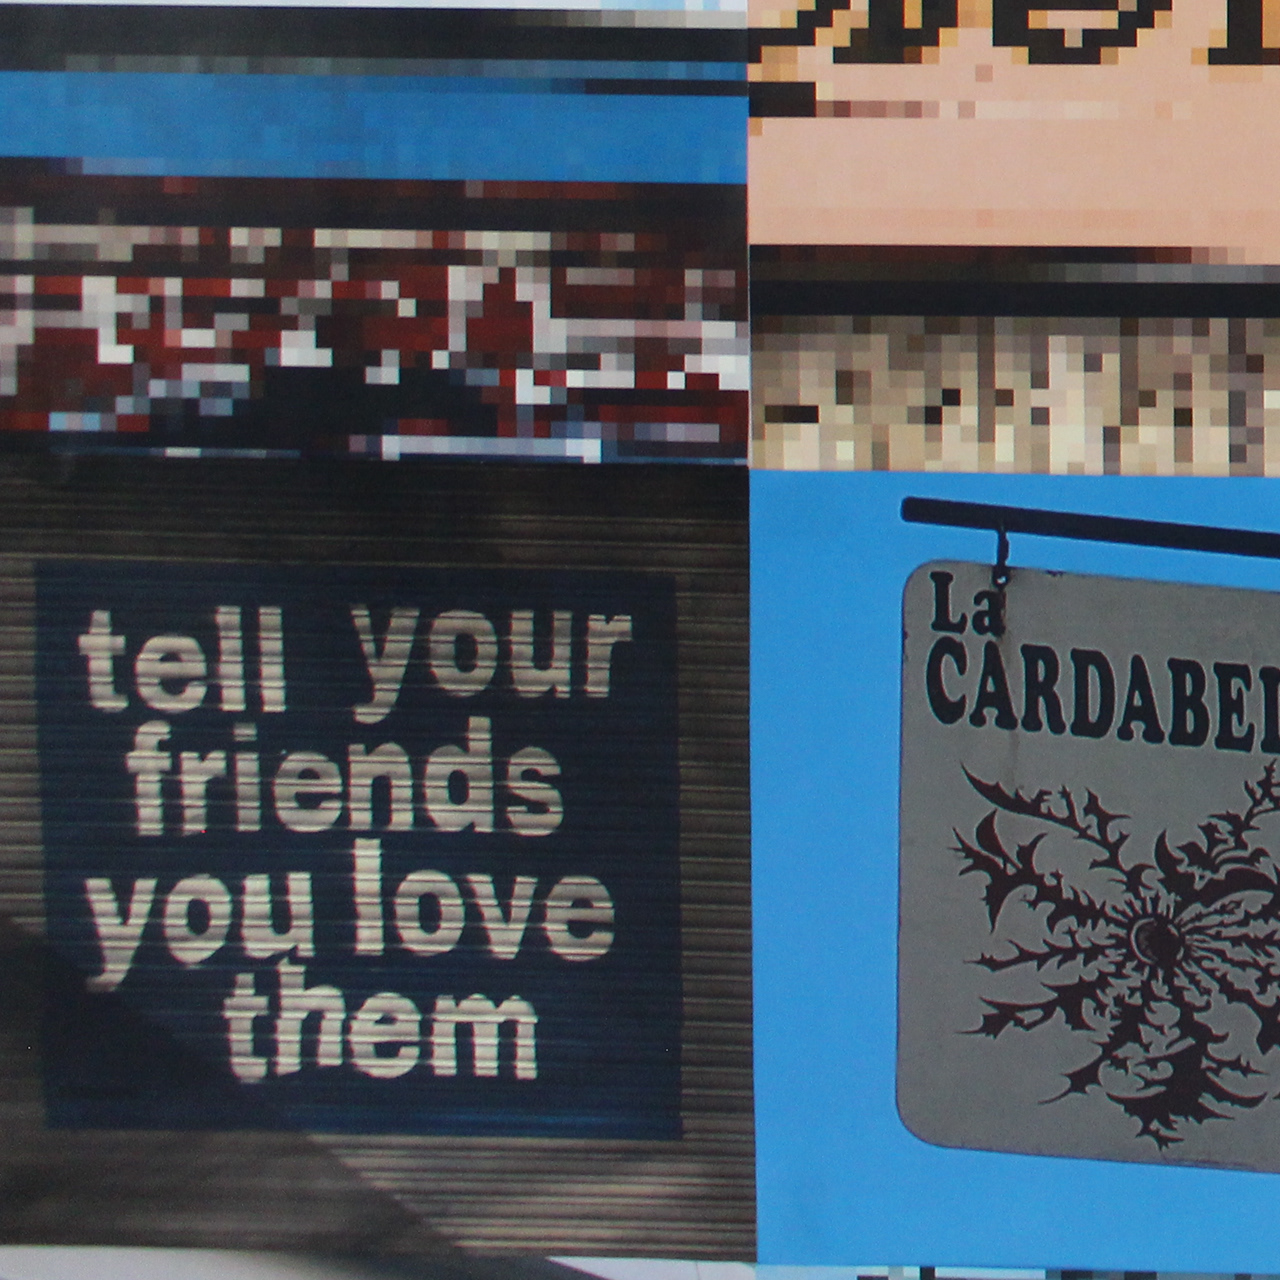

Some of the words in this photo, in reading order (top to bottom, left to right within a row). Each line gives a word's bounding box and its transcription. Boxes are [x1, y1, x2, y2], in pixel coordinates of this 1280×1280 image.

[78, 605, 287, 714] tell
[349, 603, 634, 724] your
[929, 570, 1007, 637] La
[125, 715, 565, 837] friends
[85, 871, 315, 993] you
[353, 838, 616, 962] love
[222, 958, 540, 1084] them
